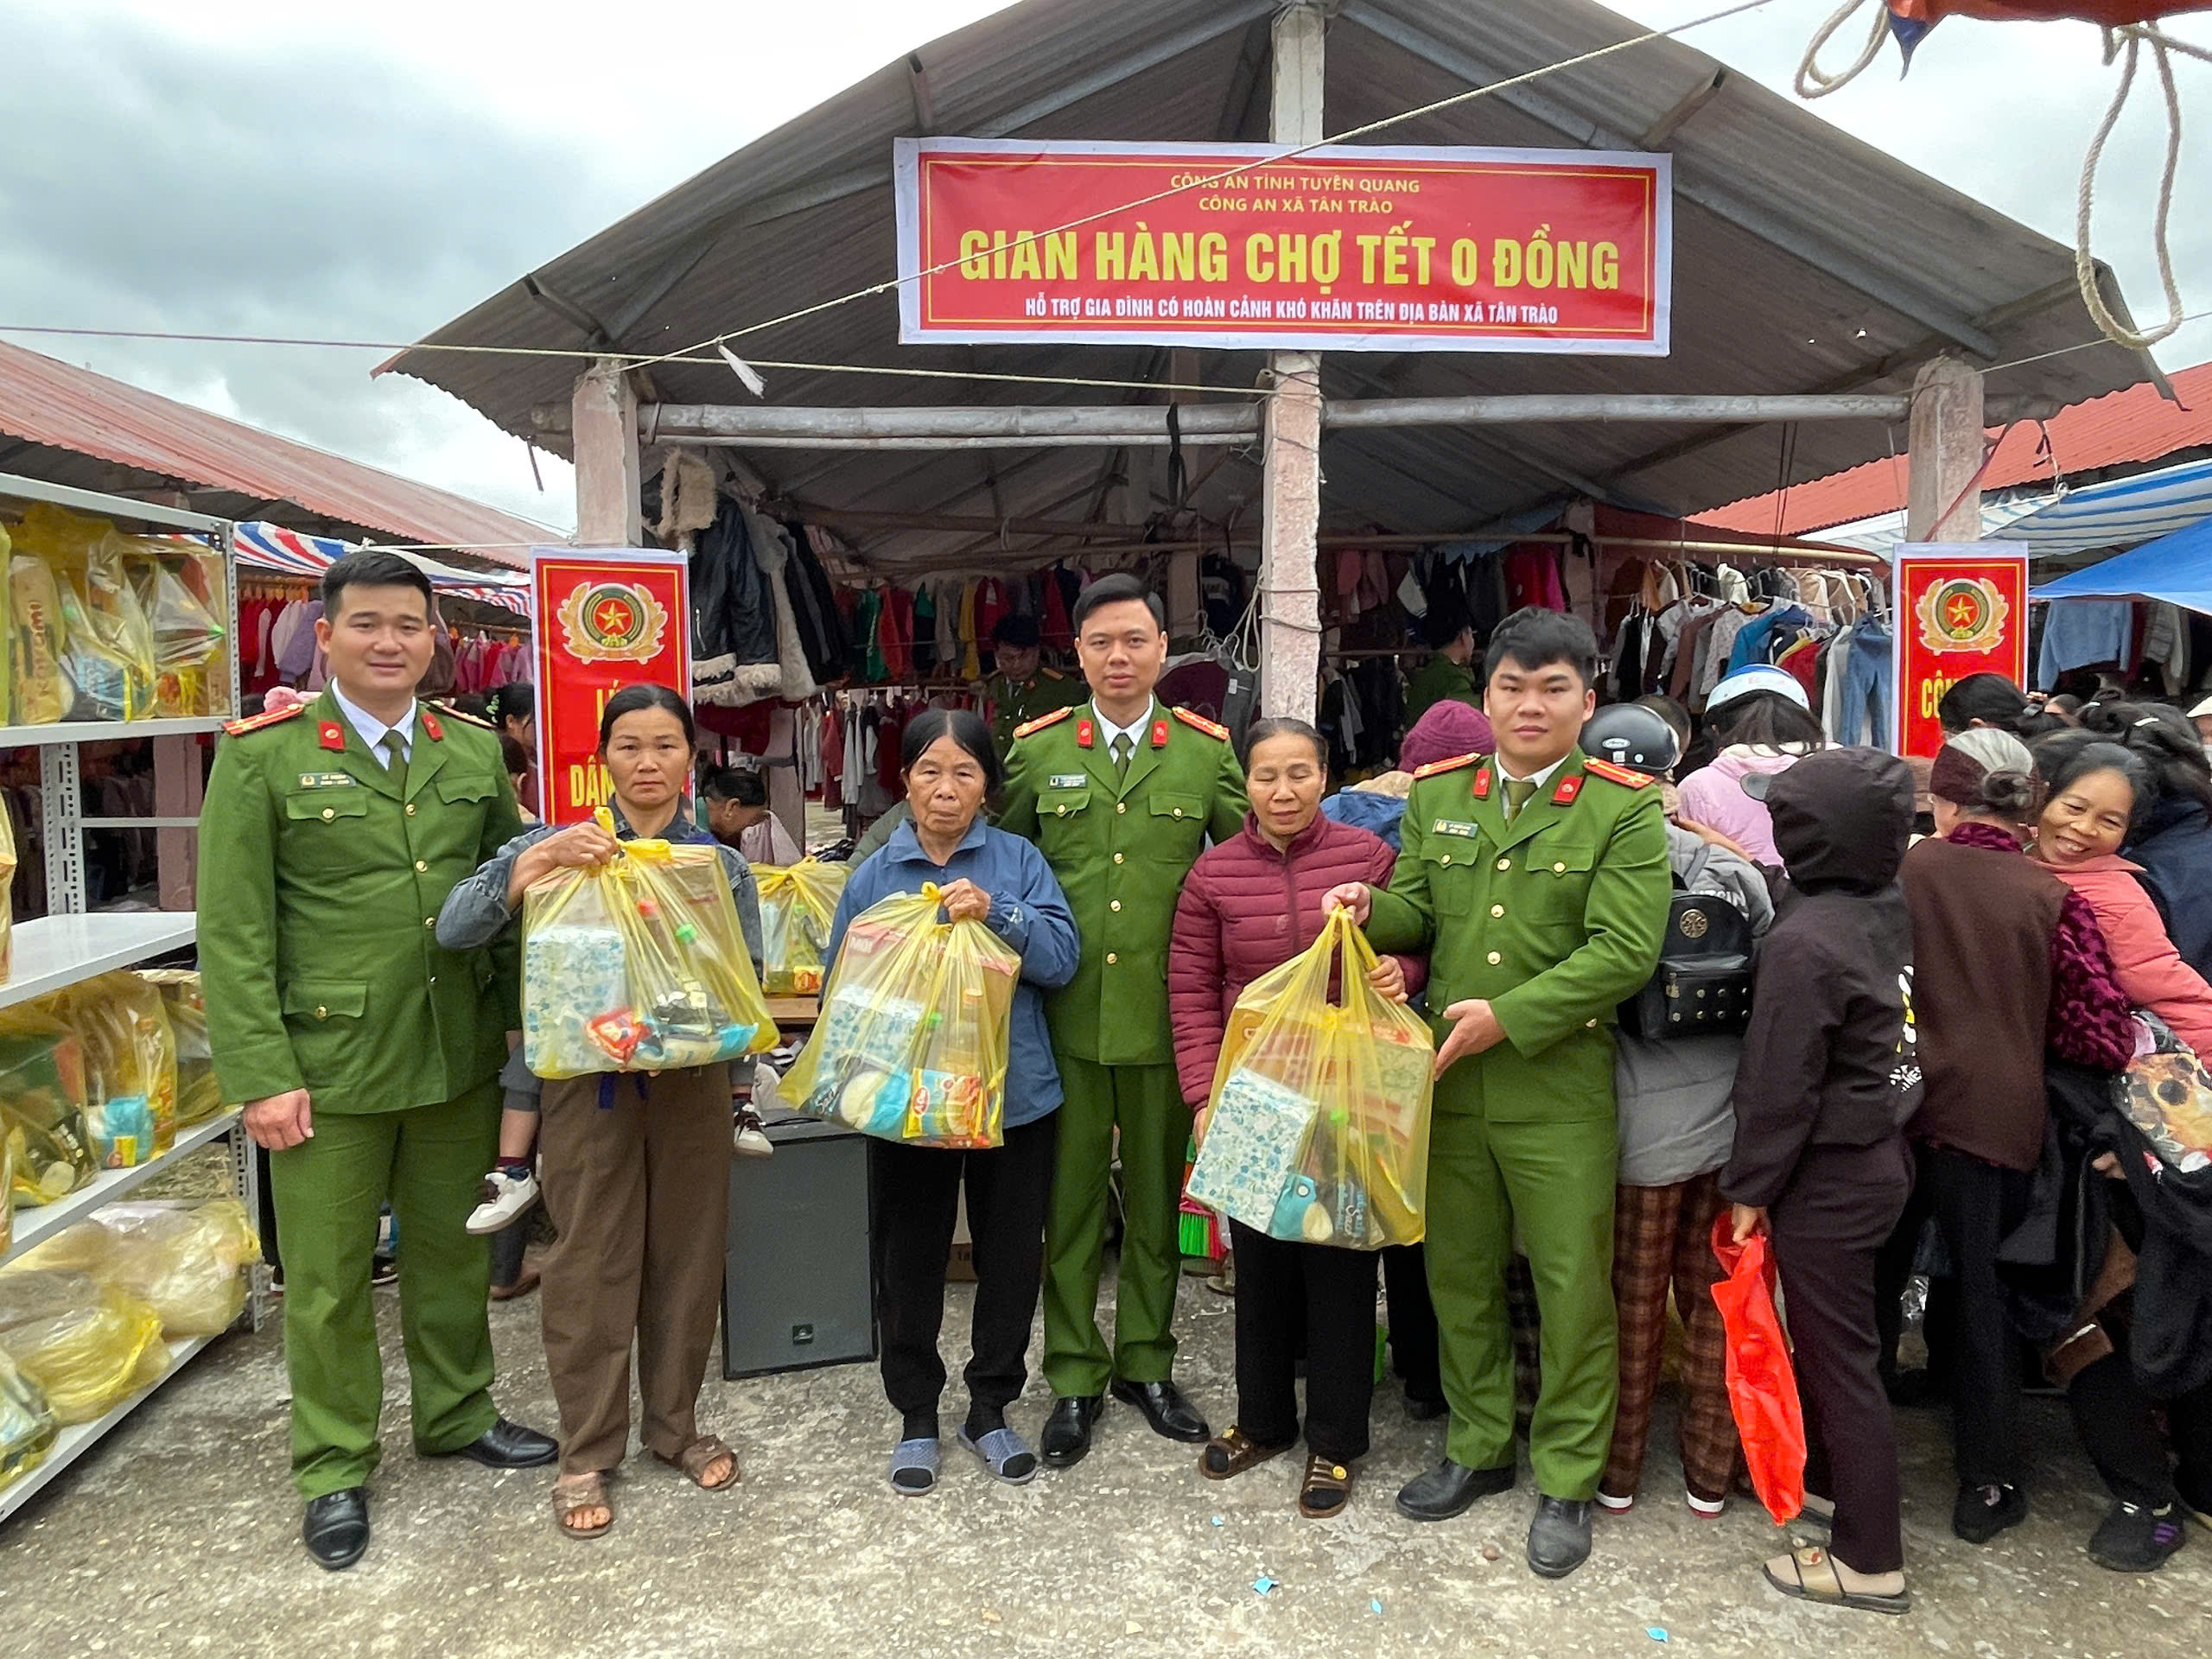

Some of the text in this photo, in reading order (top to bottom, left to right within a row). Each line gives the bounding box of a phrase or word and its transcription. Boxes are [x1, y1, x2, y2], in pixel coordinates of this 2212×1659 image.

[1170, 171, 1219, 189] CÔNG
[1224, 175, 1249, 189] AN
[1300, 175, 1355, 191] TUYÊN
[1359, 179, 1421, 194] QUANG
[1198, 194, 1393, 214] CÔNG AN XÃ TÂN TRÀO
[960, 230, 1078, 281] GIAN
[1095, 221, 1228, 282] HÀNG
[1245, 230, 1342, 295] CHỢ
[1356, 220, 1436, 285] TẾT
[1492, 224, 1618, 289] ĐỒNG
[1025, 292, 1559, 325] HỖ TRỢ GIA ĐÌNH CÓ HOÀN CẢNH KHÓ KHĂN TRÊN ĐỊA BÀN XÃ TÂN TRÀO
